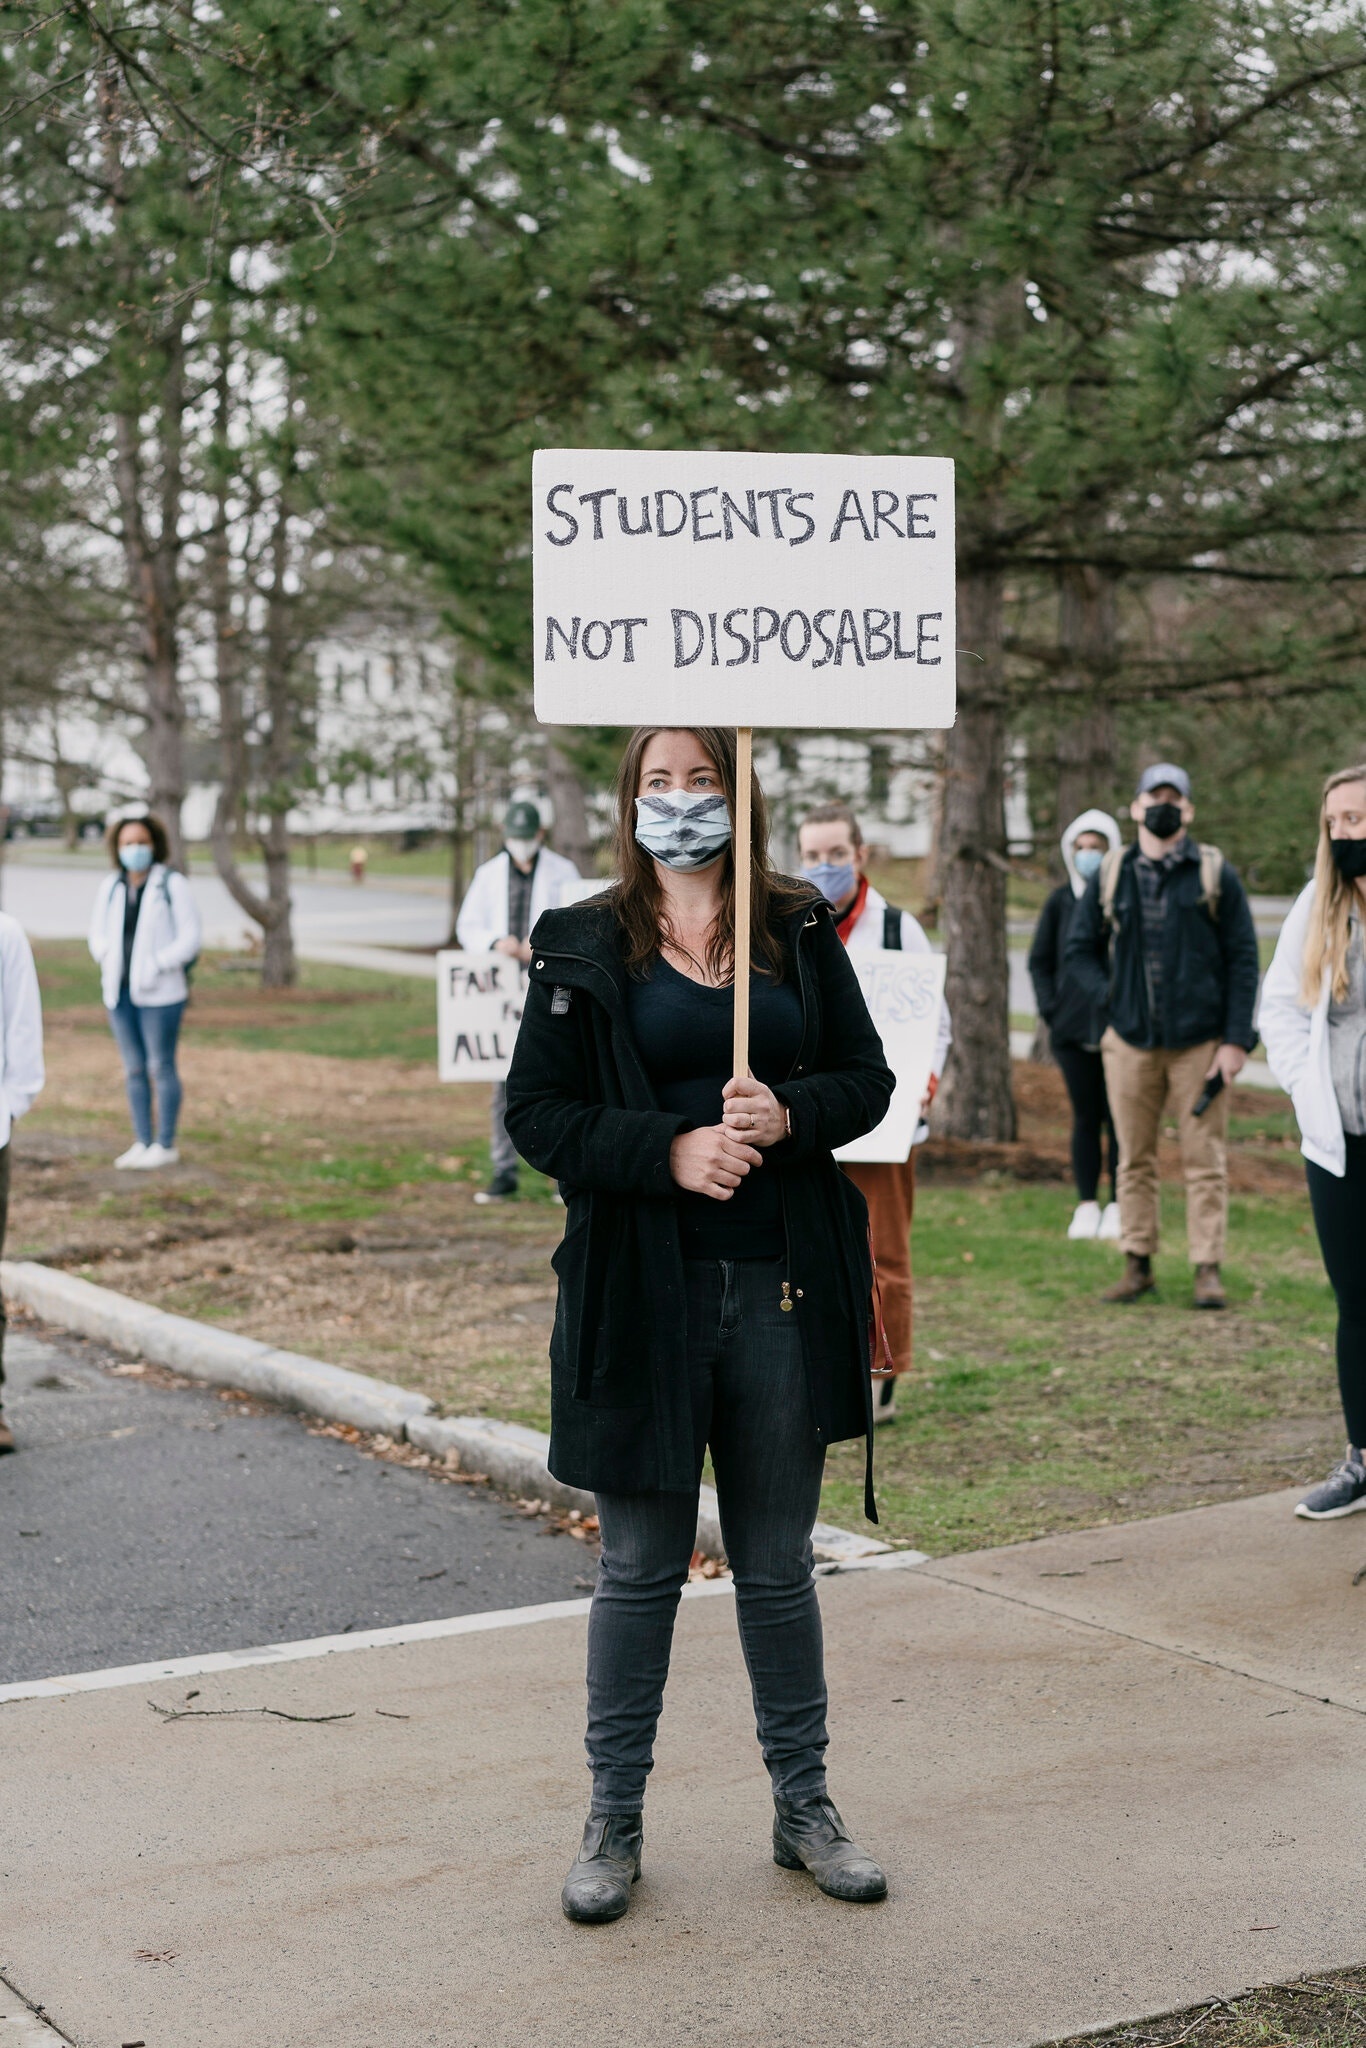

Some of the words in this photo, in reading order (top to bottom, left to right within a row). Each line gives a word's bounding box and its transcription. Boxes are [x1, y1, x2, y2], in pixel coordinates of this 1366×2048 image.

[545, 484, 816, 547] STUDENTS
[829, 489, 938, 543] ARE
[544, 615, 648, 663] NOT
[670, 606, 943, 669] DISPOSABLE
[450, 966, 503, 997] FAIR
[453, 1032, 507, 1064] ALL
